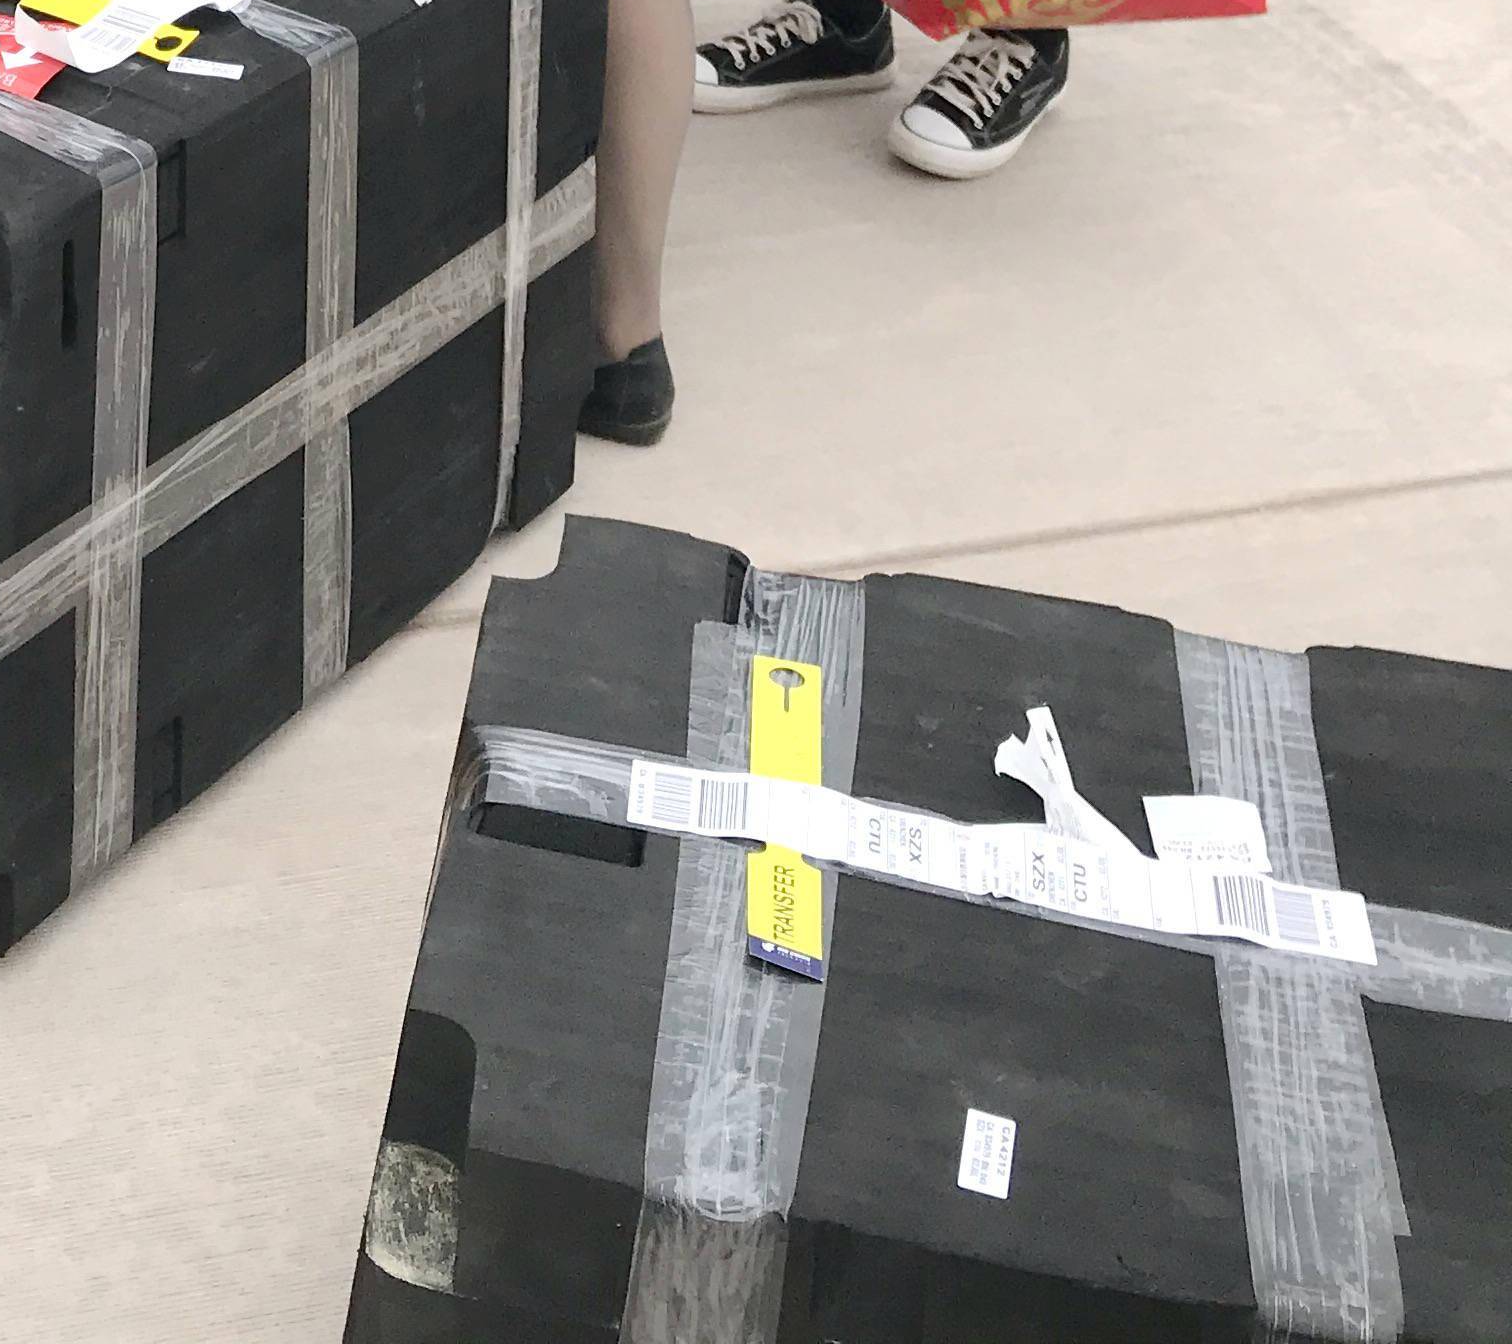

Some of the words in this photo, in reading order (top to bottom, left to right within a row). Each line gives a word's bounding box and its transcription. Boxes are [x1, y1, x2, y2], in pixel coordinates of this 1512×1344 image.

[868, 817, 882, 855] CTU
[909, 827, 922, 865] SZX
[1032, 850, 1046, 893] SZX
[1073, 862, 1088, 903] CTU
[773, 865, 795, 944] TRANSFER
